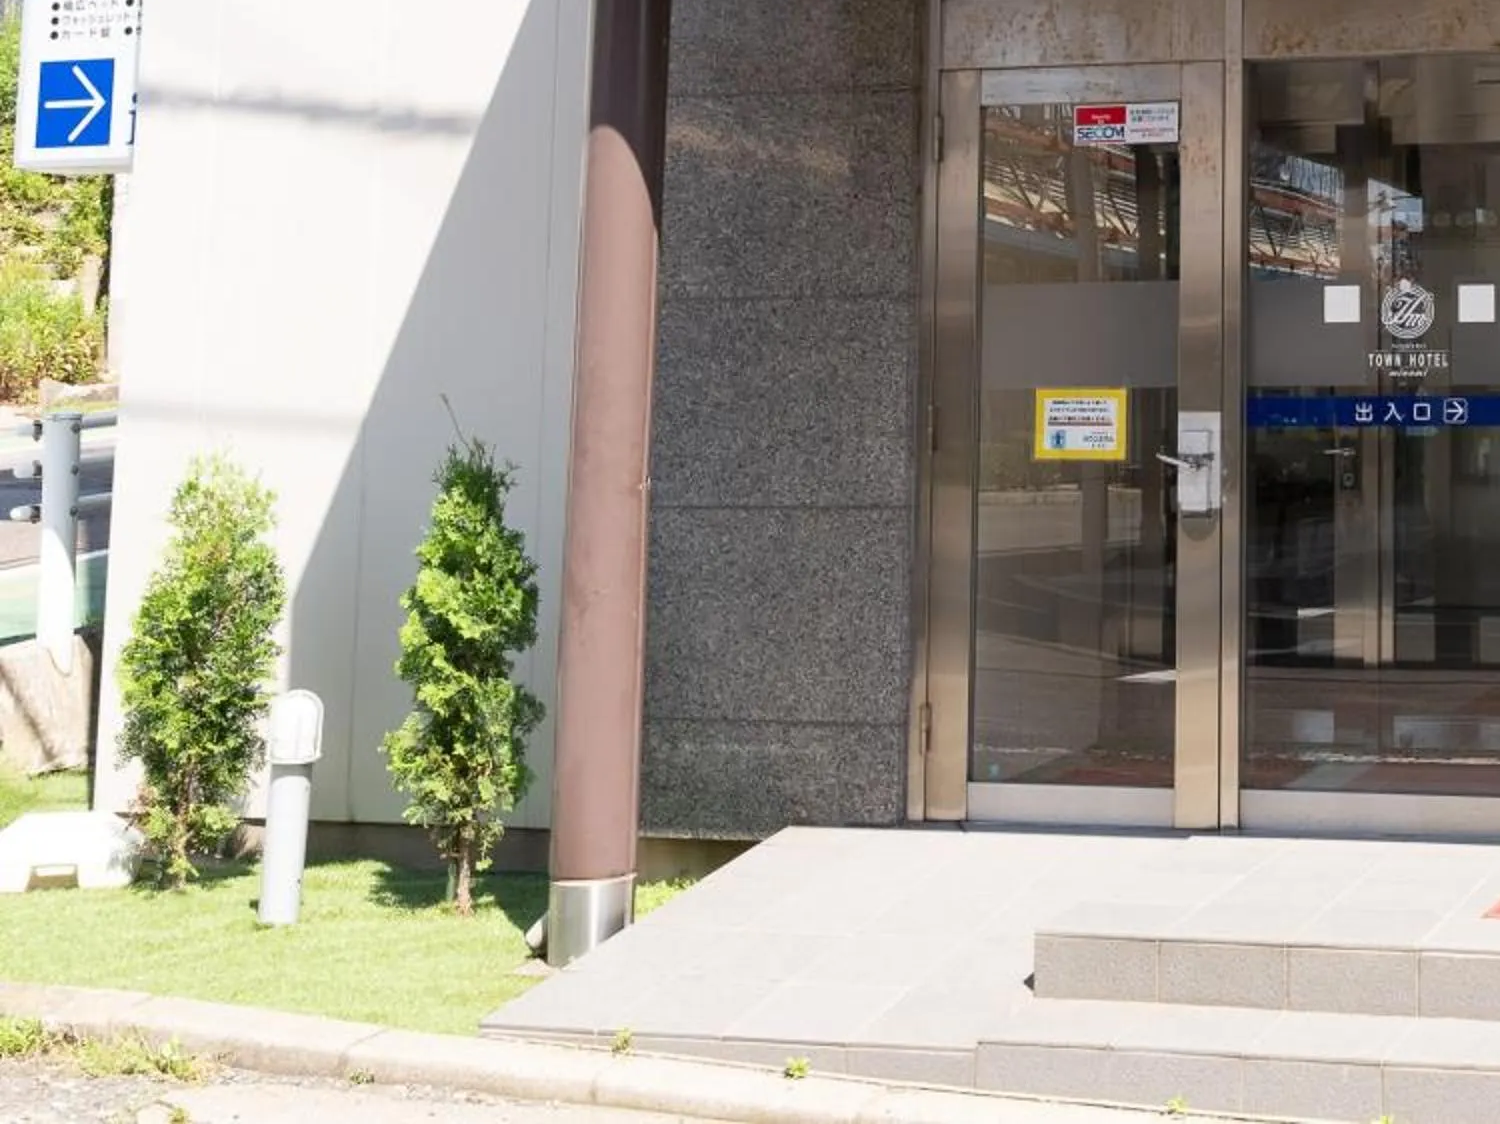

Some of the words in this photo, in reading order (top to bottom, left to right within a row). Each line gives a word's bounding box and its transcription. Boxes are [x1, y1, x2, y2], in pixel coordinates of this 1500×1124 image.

[1077, 126, 1125, 140] SECOM
[1368, 353, 1402, 368] TOWN
[1408, 352, 1449, 368] HOTEL
[1355, 401, 1431, 422] 出入口
